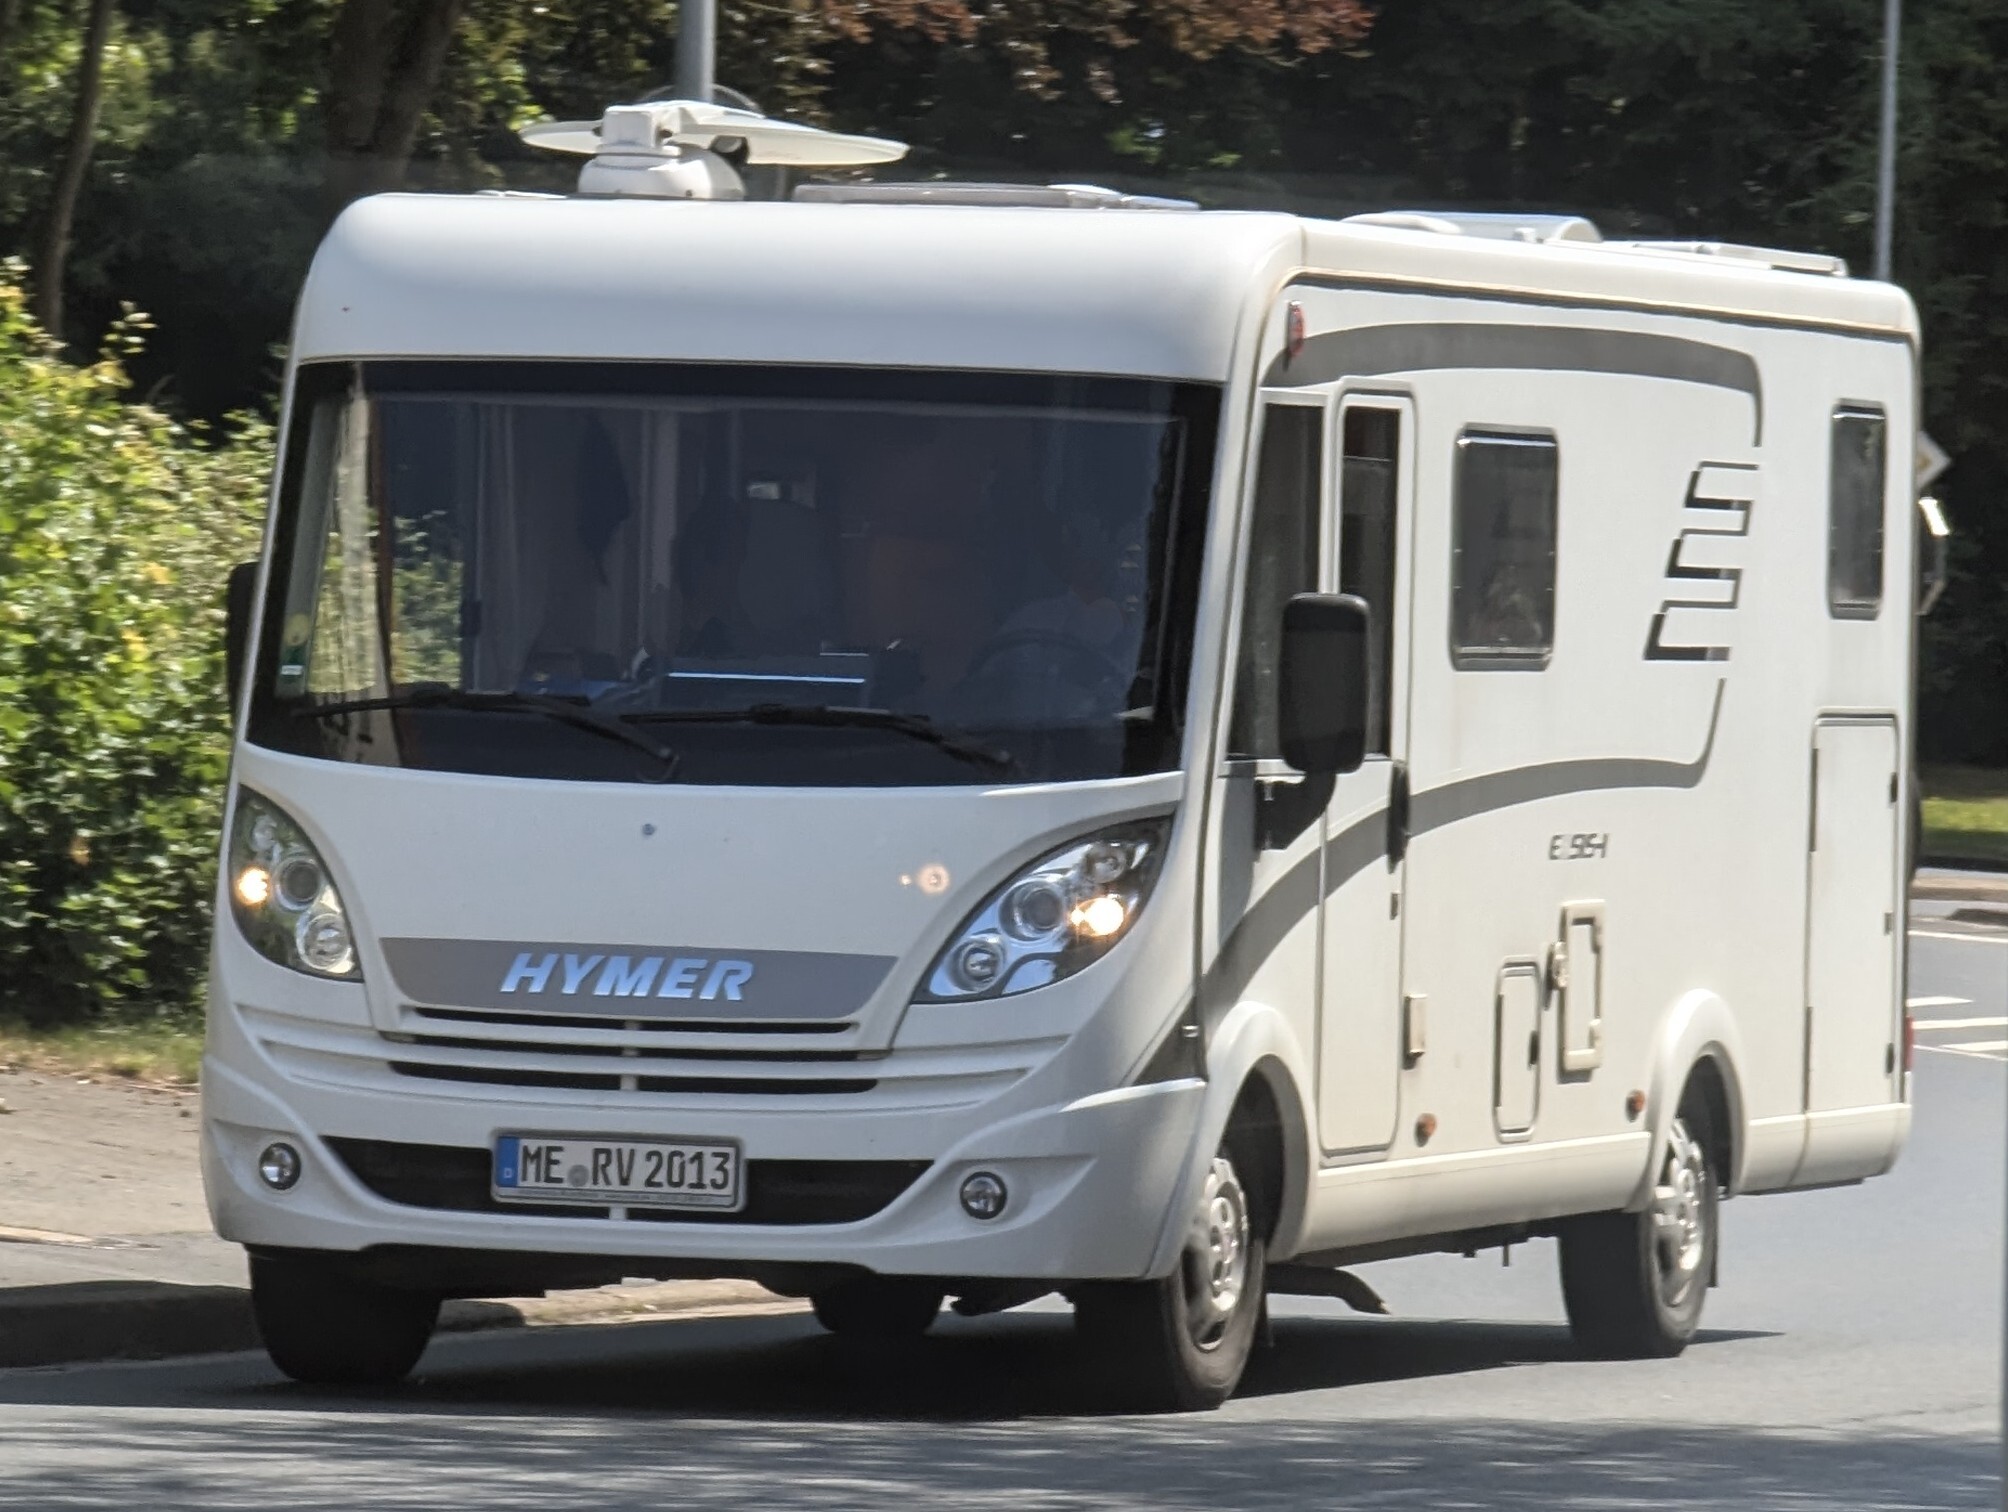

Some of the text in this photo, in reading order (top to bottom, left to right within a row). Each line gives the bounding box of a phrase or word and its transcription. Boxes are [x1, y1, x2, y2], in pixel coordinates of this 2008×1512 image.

[499, 951, 754, 1001] HYMER
[502, 1167, 513, 1179] D
[520, 1144, 731, 1190] ME RV 2013
